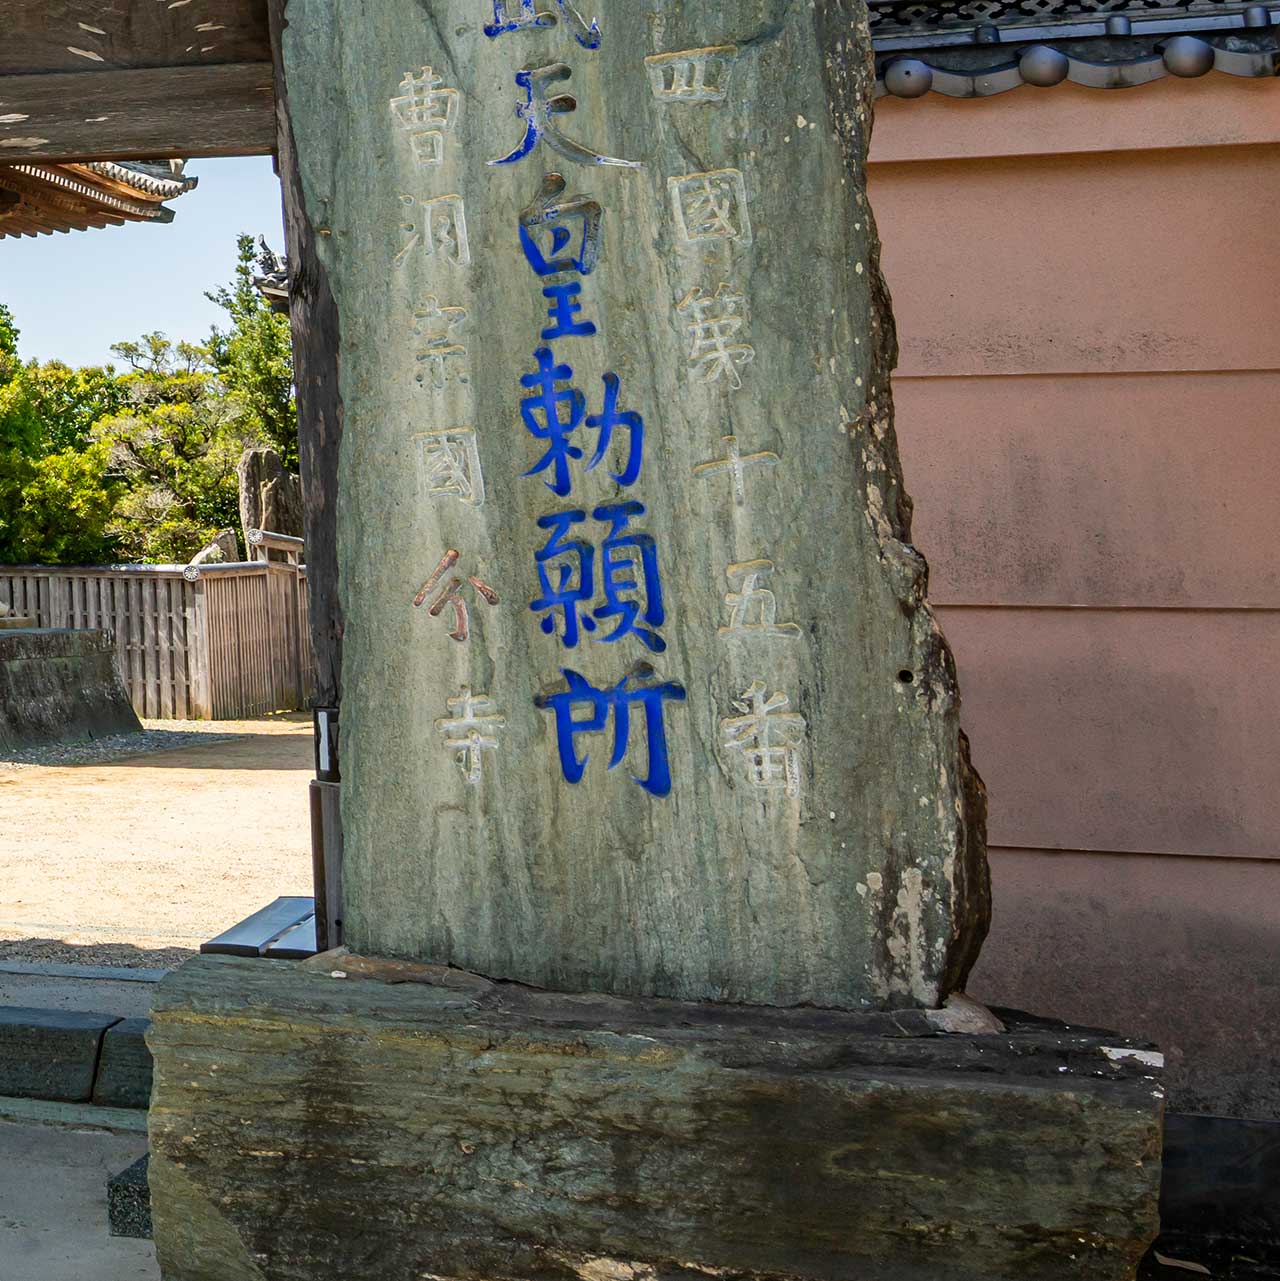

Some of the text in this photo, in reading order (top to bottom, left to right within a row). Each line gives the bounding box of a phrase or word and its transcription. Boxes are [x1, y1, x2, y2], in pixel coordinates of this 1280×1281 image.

[645, 44, 807, 797] 四國第十五番
